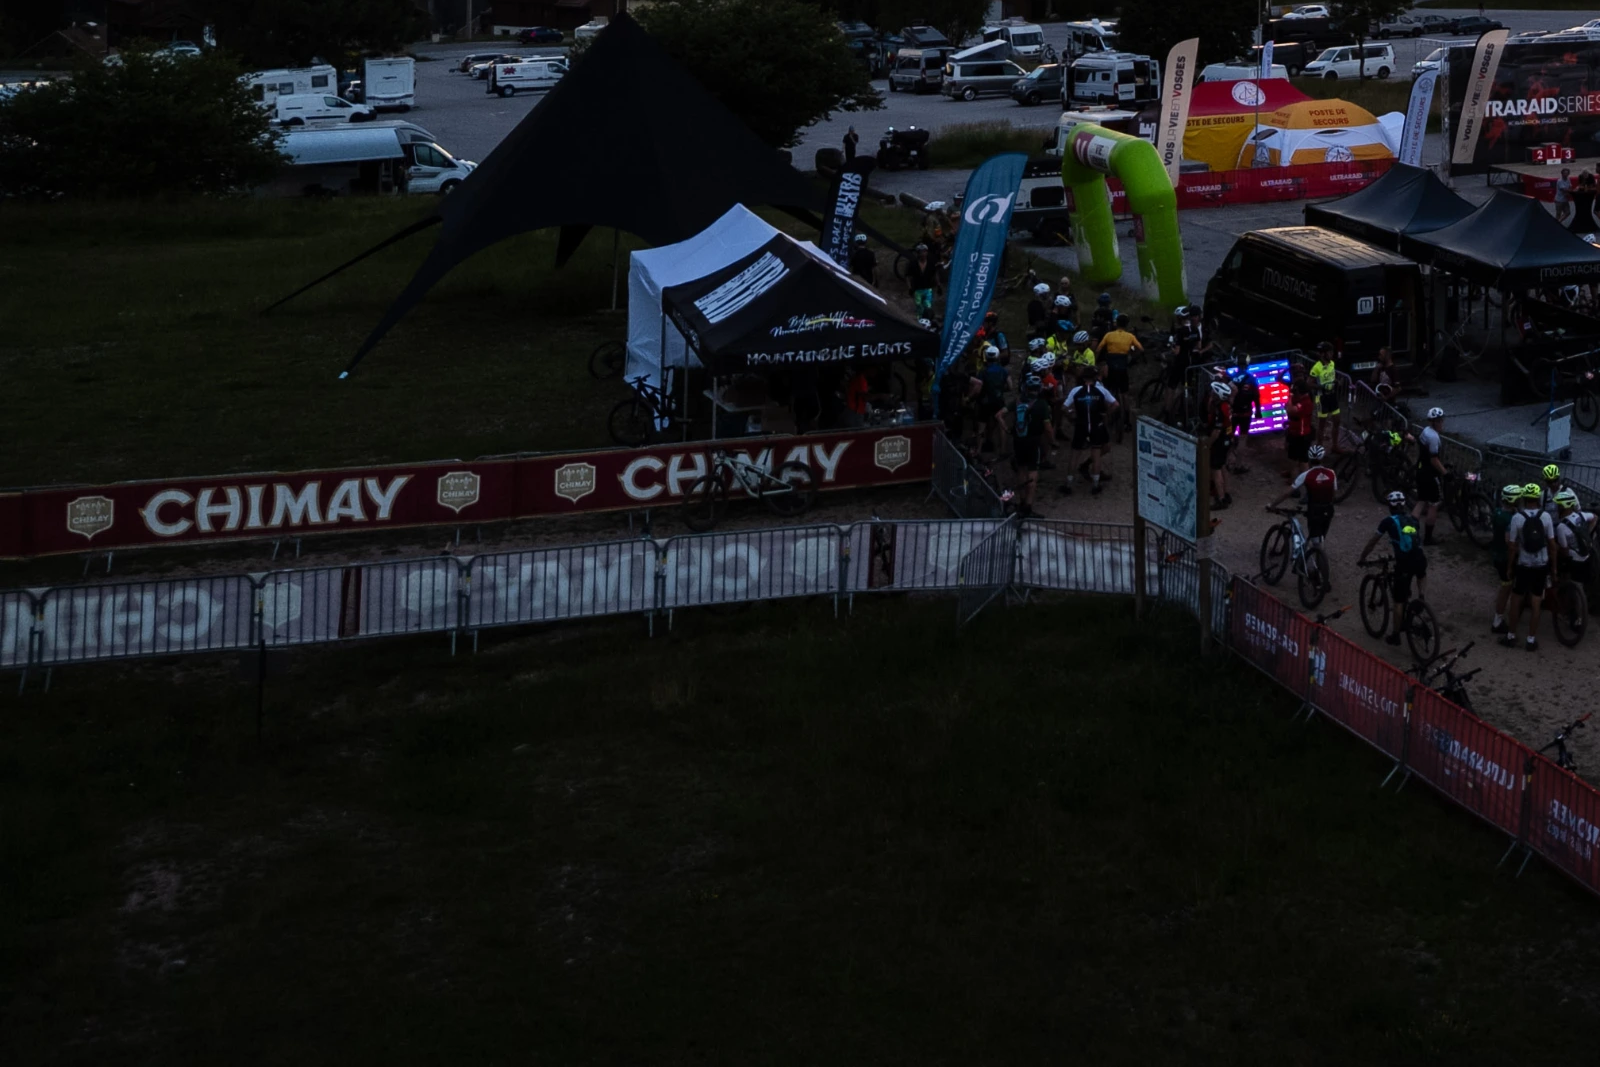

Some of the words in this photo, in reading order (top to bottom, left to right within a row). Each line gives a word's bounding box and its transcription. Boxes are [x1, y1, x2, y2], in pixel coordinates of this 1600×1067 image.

[1172, 56, 1186, 98] VOSGES
[1463, 119, 1474, 141] VOIS
[1471, 92, 1481, 107] VIE
[1479, 43, 1495, 80] VOSGES
[1169, 112, 1179, 129] VIE
[1187, 116, 1201, 126] STE
[1202, 115, 1212, 125] DE
[1212, 115, 1245, 124] SECOURS
[1313, 117, 1349, 125] SECOURS
[1336, 108, 1346, 116] DE
[1415, 96, 1426, 129] SECOURS
[1164, 142, 1175, 166] VOIS
[1262, 266, 1318, 302] MOUSTACHE
[746, 345, 855, 366] MOUNTAINBIKE
[861, 342, 912, 358] EVENTS
[138, 474, 416, 538] CHIMAY
[72, 514, 110, 524] CHIMAY
